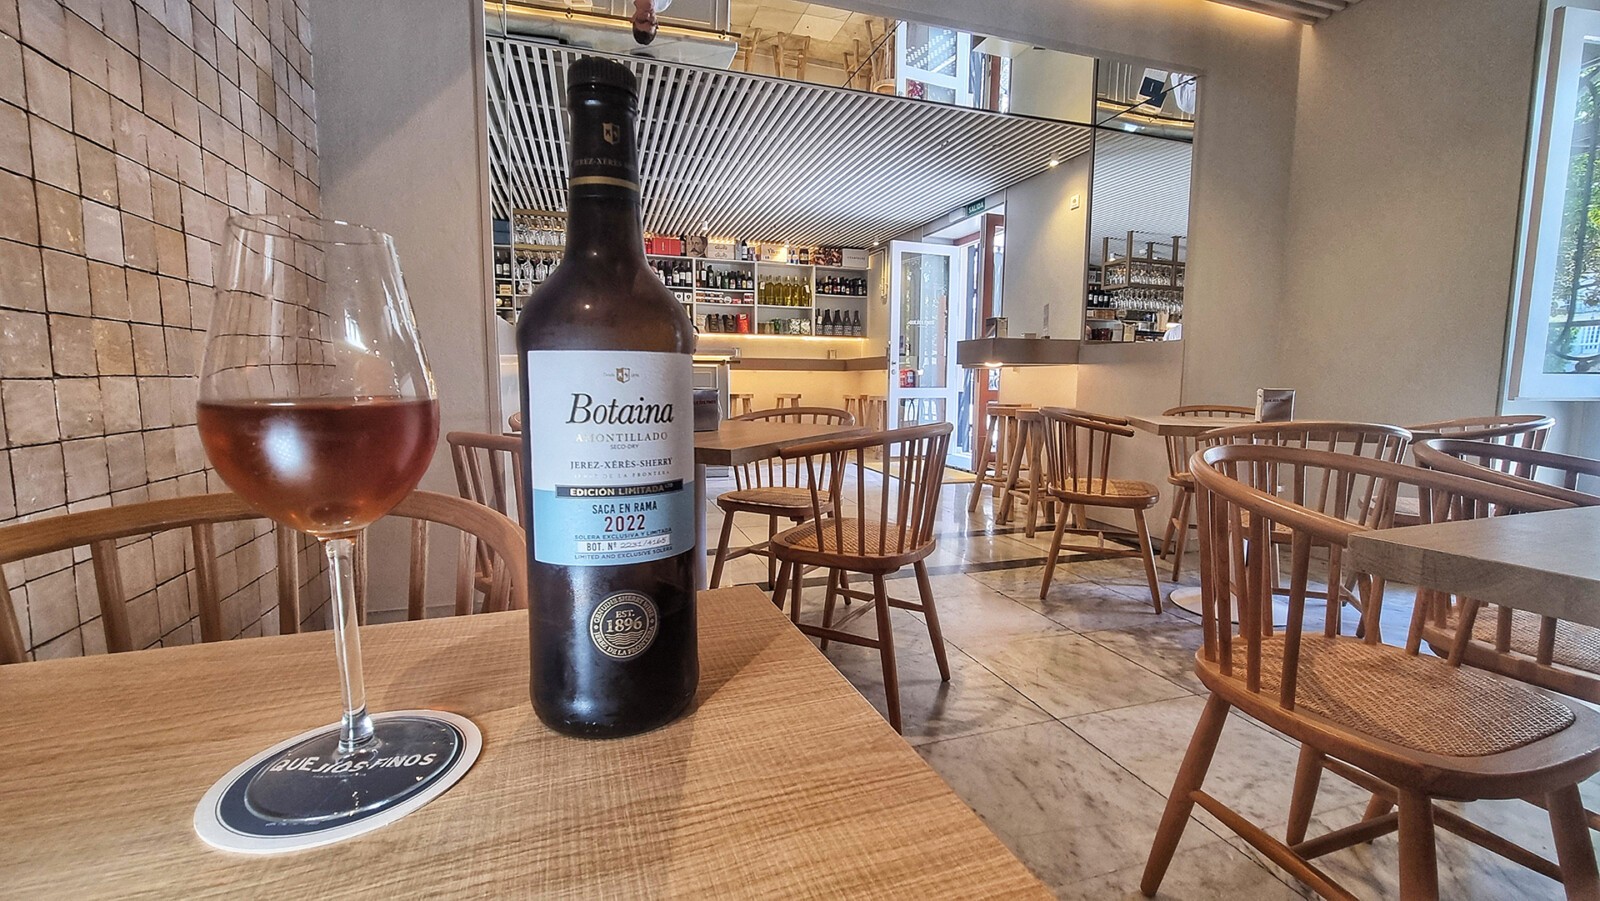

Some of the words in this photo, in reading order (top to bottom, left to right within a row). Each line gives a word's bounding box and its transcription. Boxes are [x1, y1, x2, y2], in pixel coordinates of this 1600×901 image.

[968, 201, 984, 214] SALIDA
[565, 393, 674, 425] Botaina
[618, 484, 665, 495] LIMITADA
[592, 504, 616, 514] SACA
[619, 503, 631, 513] EN
[634, 501, 658, 512] RAMA
[604, 514, 646, 532] 2022
[602, 532, 639, 540] EXCLUSIVA
[646, 527, 672, 536] LIMITADA
[586, 542, 605, 552] BOT.
[617, 550, 651, 558] EXCLUSIVE
[652, 546, 673, 554] SOLERA
[615, 609, 635, 618] EST.
[606, 616, 642, 633] 1896
